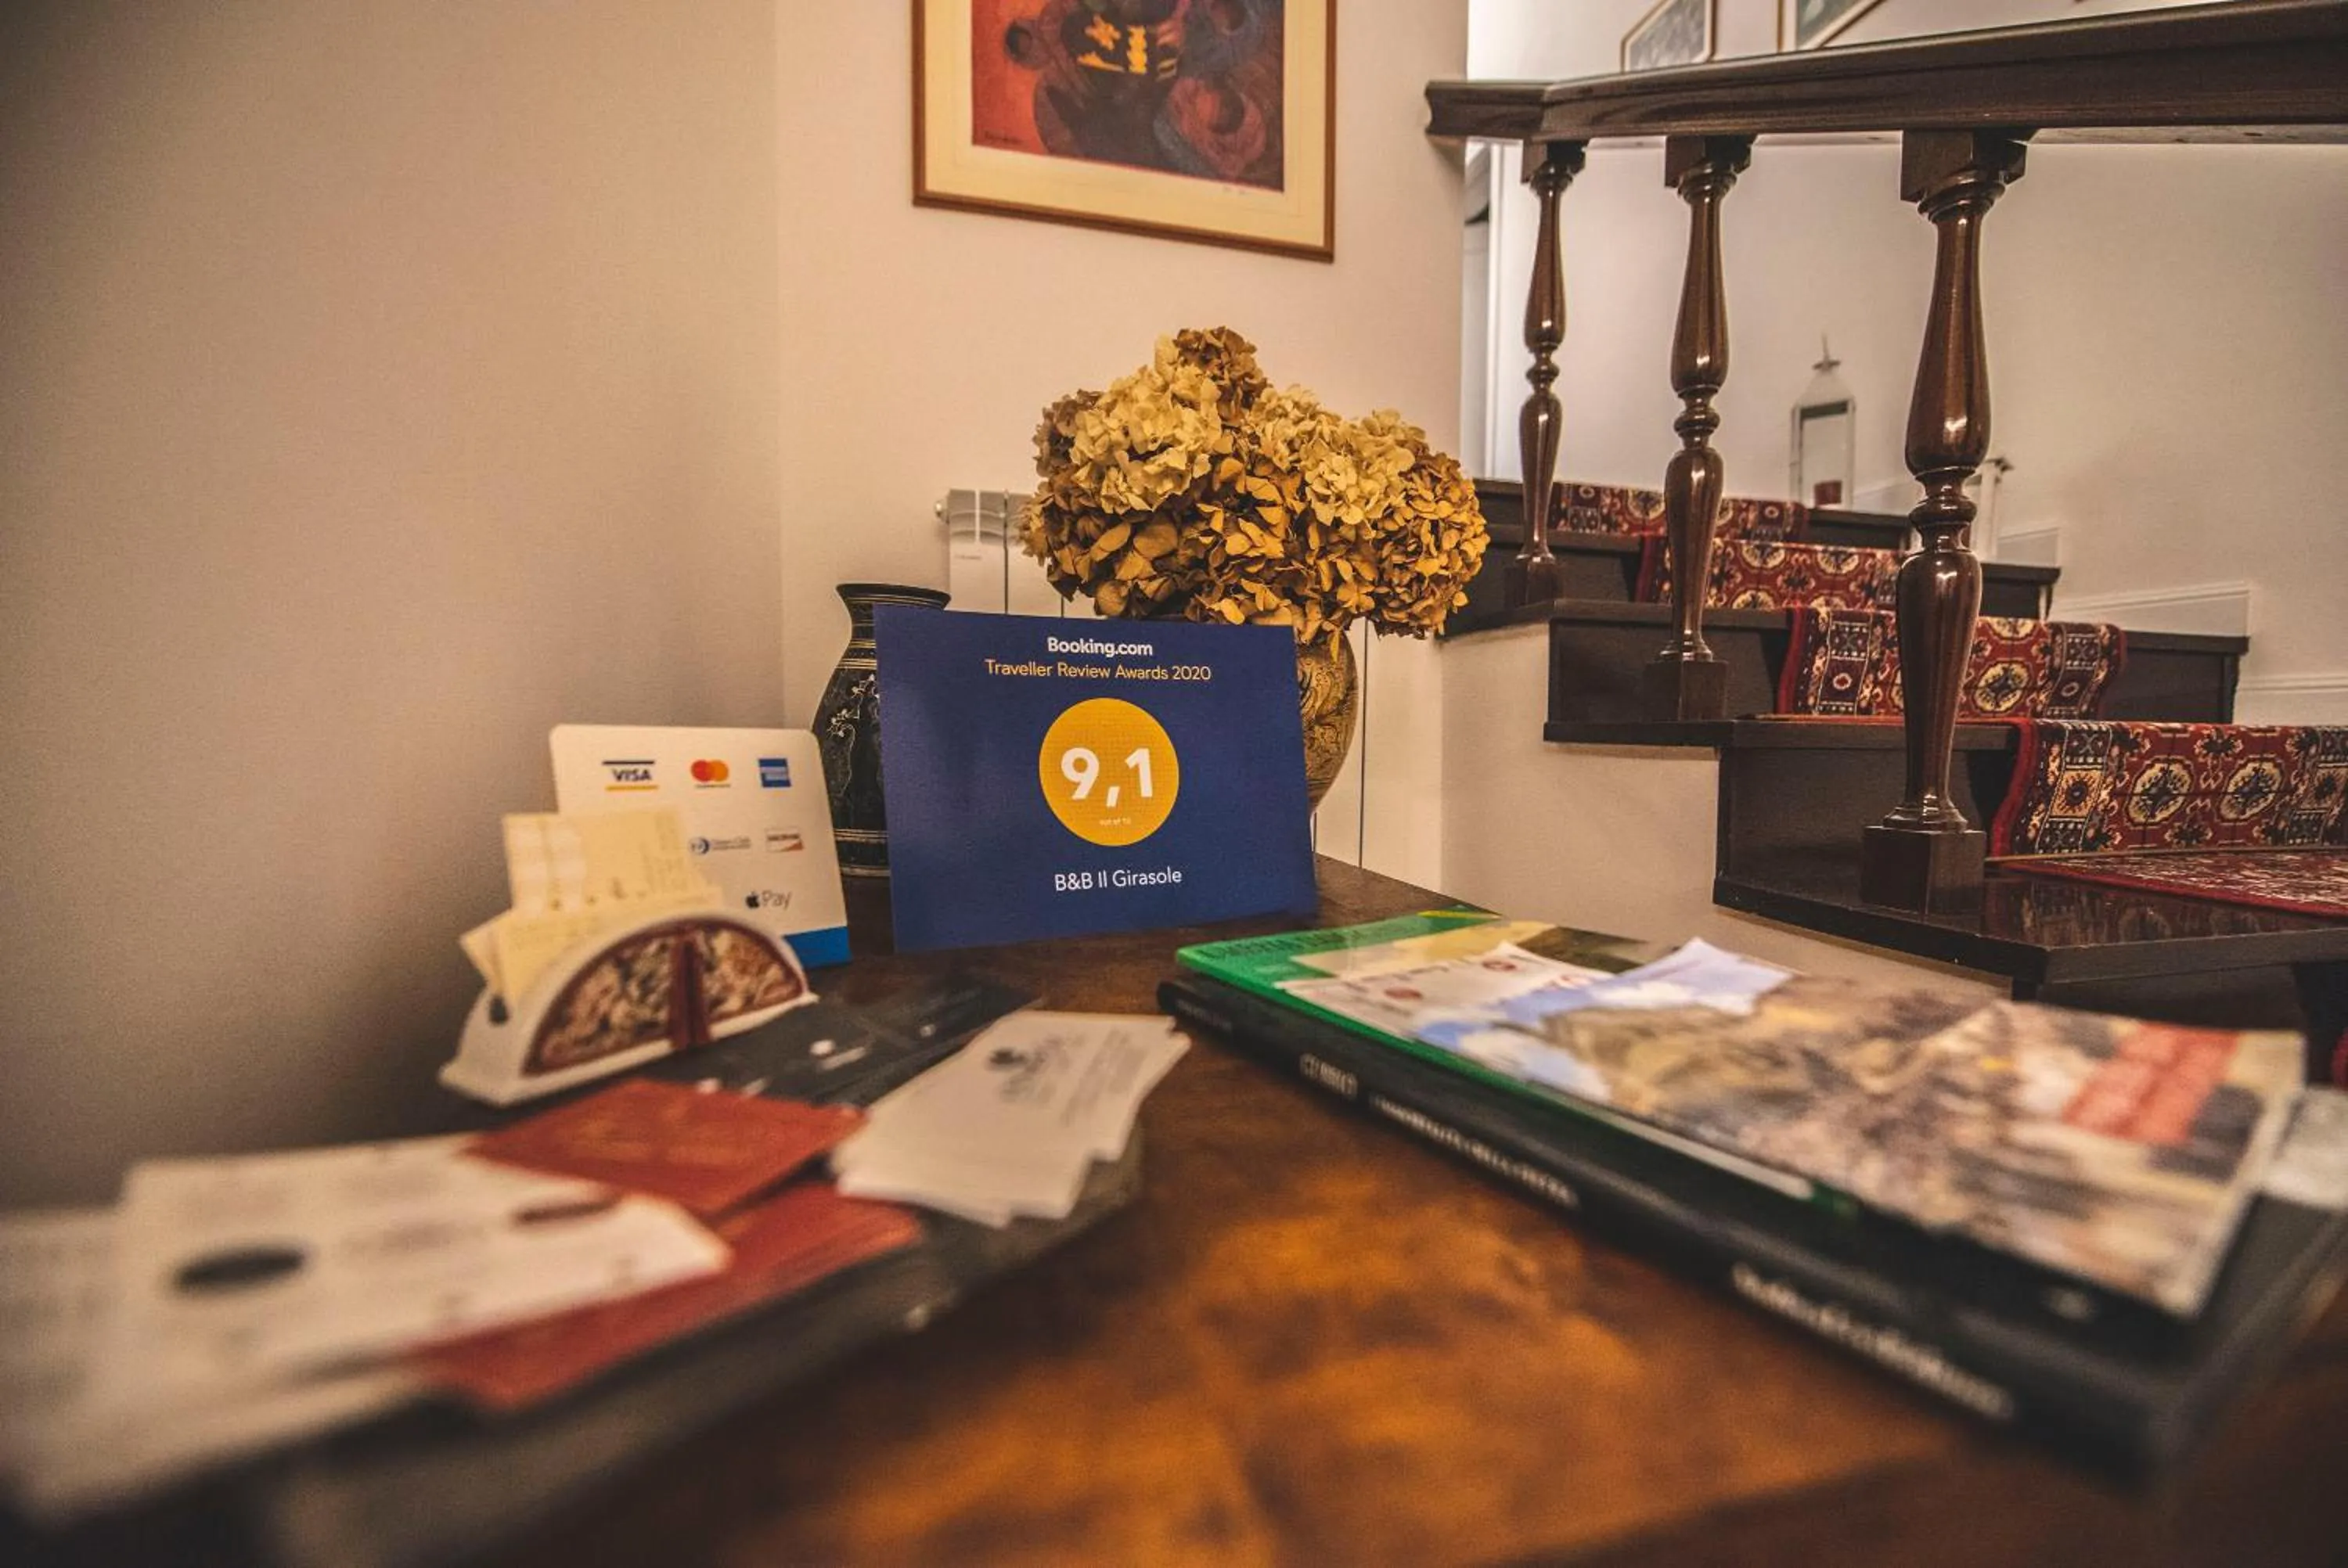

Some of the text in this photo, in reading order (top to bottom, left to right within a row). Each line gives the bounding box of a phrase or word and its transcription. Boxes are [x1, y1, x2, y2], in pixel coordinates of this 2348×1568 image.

[1046, 636, 1153, 658] Booking.com
[985, 658, 1211, 680] Traveller Review Awards 2020
[611, 768, 652, 782] VISA
[1061, 746, 1154, 808] 9,1
[1054, 872, 1093, 891] B&B
[1112, 865, 1183, 886] Girasole
[762, 890, 793, 911] Pay
